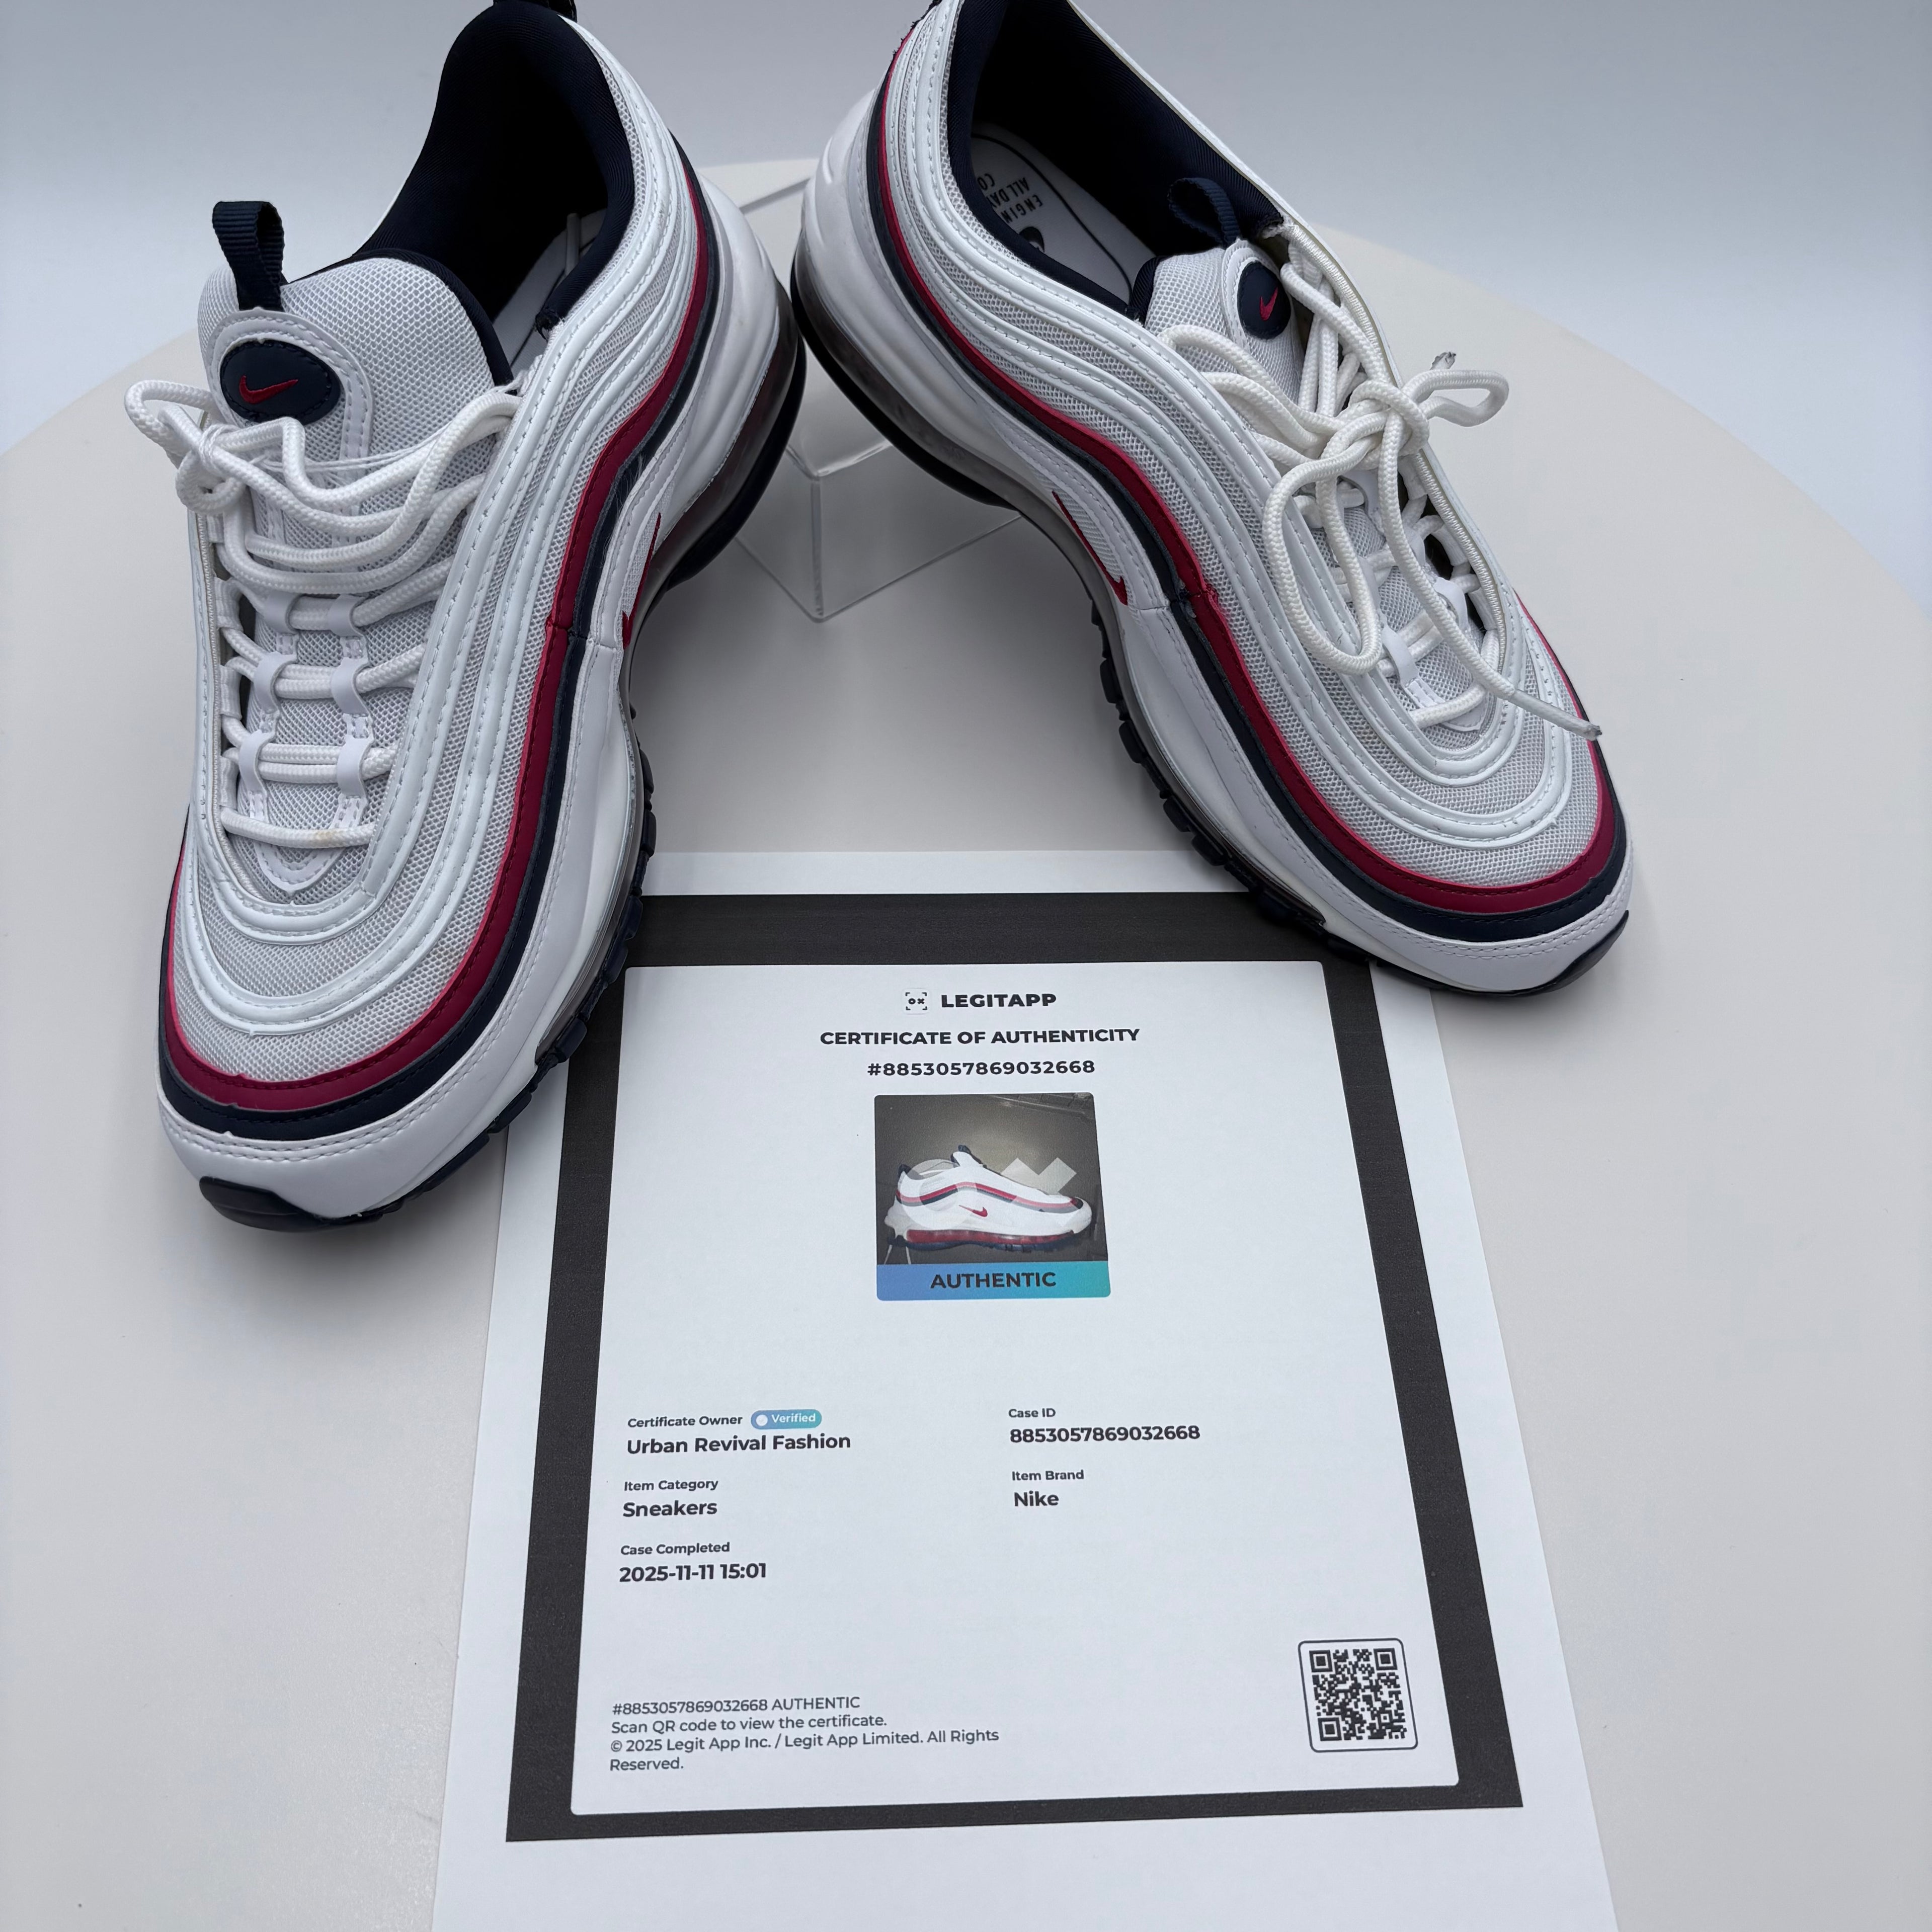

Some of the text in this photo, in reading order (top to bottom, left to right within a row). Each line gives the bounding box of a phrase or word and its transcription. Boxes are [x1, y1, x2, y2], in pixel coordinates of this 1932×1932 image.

[1006, 178, 1029, 197] ALL
[941, 993, 1057, 1008] LEGITAPP
[820, 1028, 1140, 1045] CERTIFICATE OF AUTHENTICITY
[867, 1060, 1095, 1076] #8853057869032668
[930, 1272, 1057, 1289] AUTHENTIC
[771, 1413, 816, 1423] Verified
[1008, 1408, 1056, 1418] Case ID
[627, 1416, 743, 1428] Certificate Owner
[1010, 1425, 1200, 1443] 8853057869032668
[627, 1432, 851, 1455] Urban Revival Fashion
[1012, 1469, 1084, 1481] Item Brand
[624, 1480, 718, 1492] Item Category
[1014, 1490, 1059, 1507] Nike
[623, 1500, 717, 1517] Sneakers
[620, 1542, 730, 1556] Case Completed
[619, 1563, 766, 1582] 2025-11-11 15:01
[612, 1696, 860, 1715] #8853057869032668 AUTHENTIC
[611, 1714, 887, 1735] Scan QR code to view the certificate.
[626, 1739, 663, 1752] 2025
[667, 1737, 705, 1753] Legit
[708, 1737, 741, 1752] App
[745, 1736, 771, 1748] Inc.
[785, 1733, 823, 1750] Legit
[826, 1734, 858, 1748] App
[863, 1731, 924, 1745] Limited.
[927, 1730, 946, 1743] All
[950, 1729, 999, 1745] Rights
[610, 1756, 684, 1771] Reserved.
